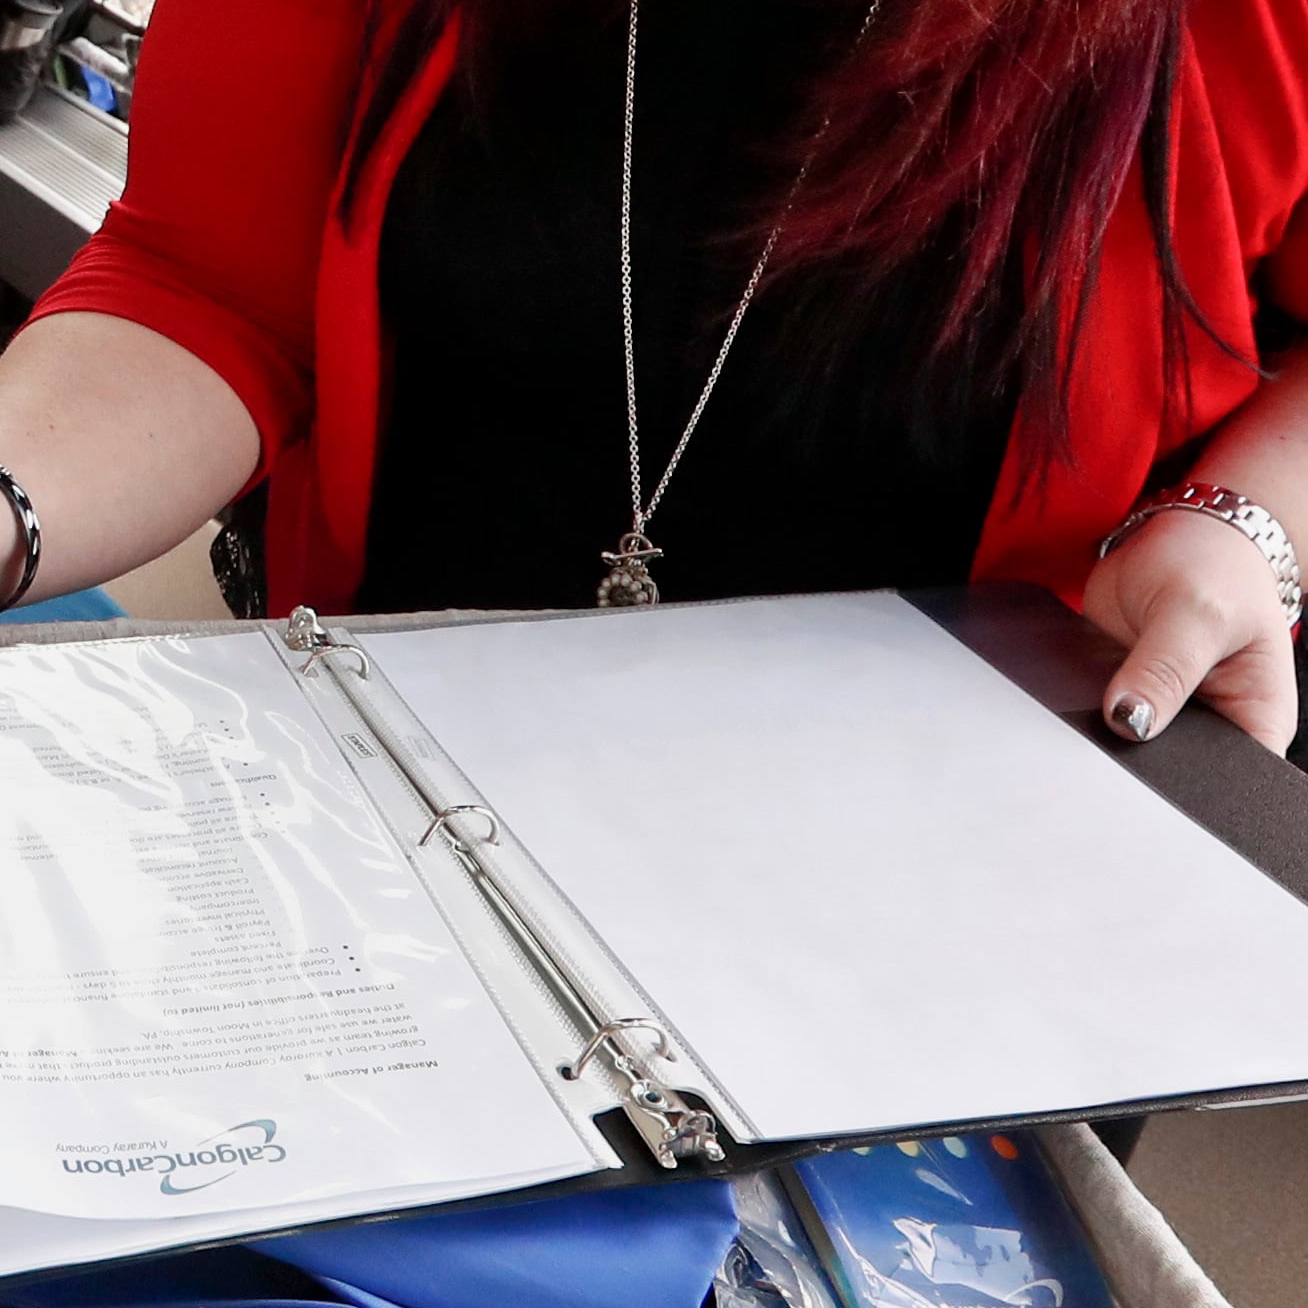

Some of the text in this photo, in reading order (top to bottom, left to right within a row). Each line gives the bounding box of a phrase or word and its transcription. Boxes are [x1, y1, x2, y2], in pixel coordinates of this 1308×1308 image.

[210, 774, 277, 788] Qualificaons
[213, 831, 268, 844] Coodinate
[198, 857, 238, 869] Account
[193, 867, 244, 879] Derivative
[167, 877, 249, 894] Cash application
[176, 888, 255, 903] Product costing
[190, 897, 260, 912] Intercompany
[165, 908, 265, 927] Physical invenories
[192, 924, 222, 935] frige
[235, 919, 271, 930] Payroll
[214, 930, 276, 943] Fixed assets
[190, 941, 282, 959] Percent complete
[286, 946, 329, 960] Overe
[265, 952, 284, 961] the
[254, 965, 273, 974] and
[277, 958, 336, 971] Coordiate
[73, 969, 109, 980] ensure
[210, 966, 251, 978] manage
[278, 969, 341, 981] Prepartion
[162, 971, 207, 985] monthly
[265, 976, 276, 985] of
[83, 981, 107, 990] days
[171, 986, 192, 996] and
[195, 979, 262, 992] consolidatd
[359, 982, 395, 993] Duties
[336, 988, 355, 998] and
[181, 1005, 220, 1016] limited
[222, 1002, 245, 1013] (not
[373, 1004, 391, 1013] the
[393, 1002, 405, 1010] at
[163, 1008, 178, 1017] to)
[298, 1007, 371, 1024] headquarters
[252, 1019, 262, 1028] in
[265, 1016, 296, 1026] office
[340, 1020, 358, 1029] use
[361, 1018, 378, 1026] we
[381, 1014, 413, 1025] water
[217, 1022, 249, 1034] Moon
[297, 1027, 312, 1036] for
[373, 1025, 418, 1039] growing
[310, 1038, 324, 1046] we
[343, 1032, 372, 1041] team
[134, 1044, 151, 1052] are
[154, 1043, 173, 1052] We
[244, 1046, 262, 1054] our
[265, 1040, 306, 1052] provide
[346, 1044, 386, 1054] Carbon
[388, 1039, 426, 1050] Calgon
[91, 1046, 131, 1056] seekin
[183, 1049, 240, 1061] customers
[64, 1059, 112, 1070] product
[115, 1054, 181, 1066] outstanding
[224, 1058, 276, 1069] Company
[38, 1062, 61, 1071] that
[172, 1064, 222, 1076] currently
[372, 1066, 383, 1074] of
[388, 1060, 439, 1073] Manager
[2, 1074, 22, 1083] you
[149, 1069, 169, 1078] has
[26, 1076, 61, 1084] where
[55, 1139, 168, 1155] A Kuraray Company
[62, 1143, 286, 1177] CalgonCarbon
